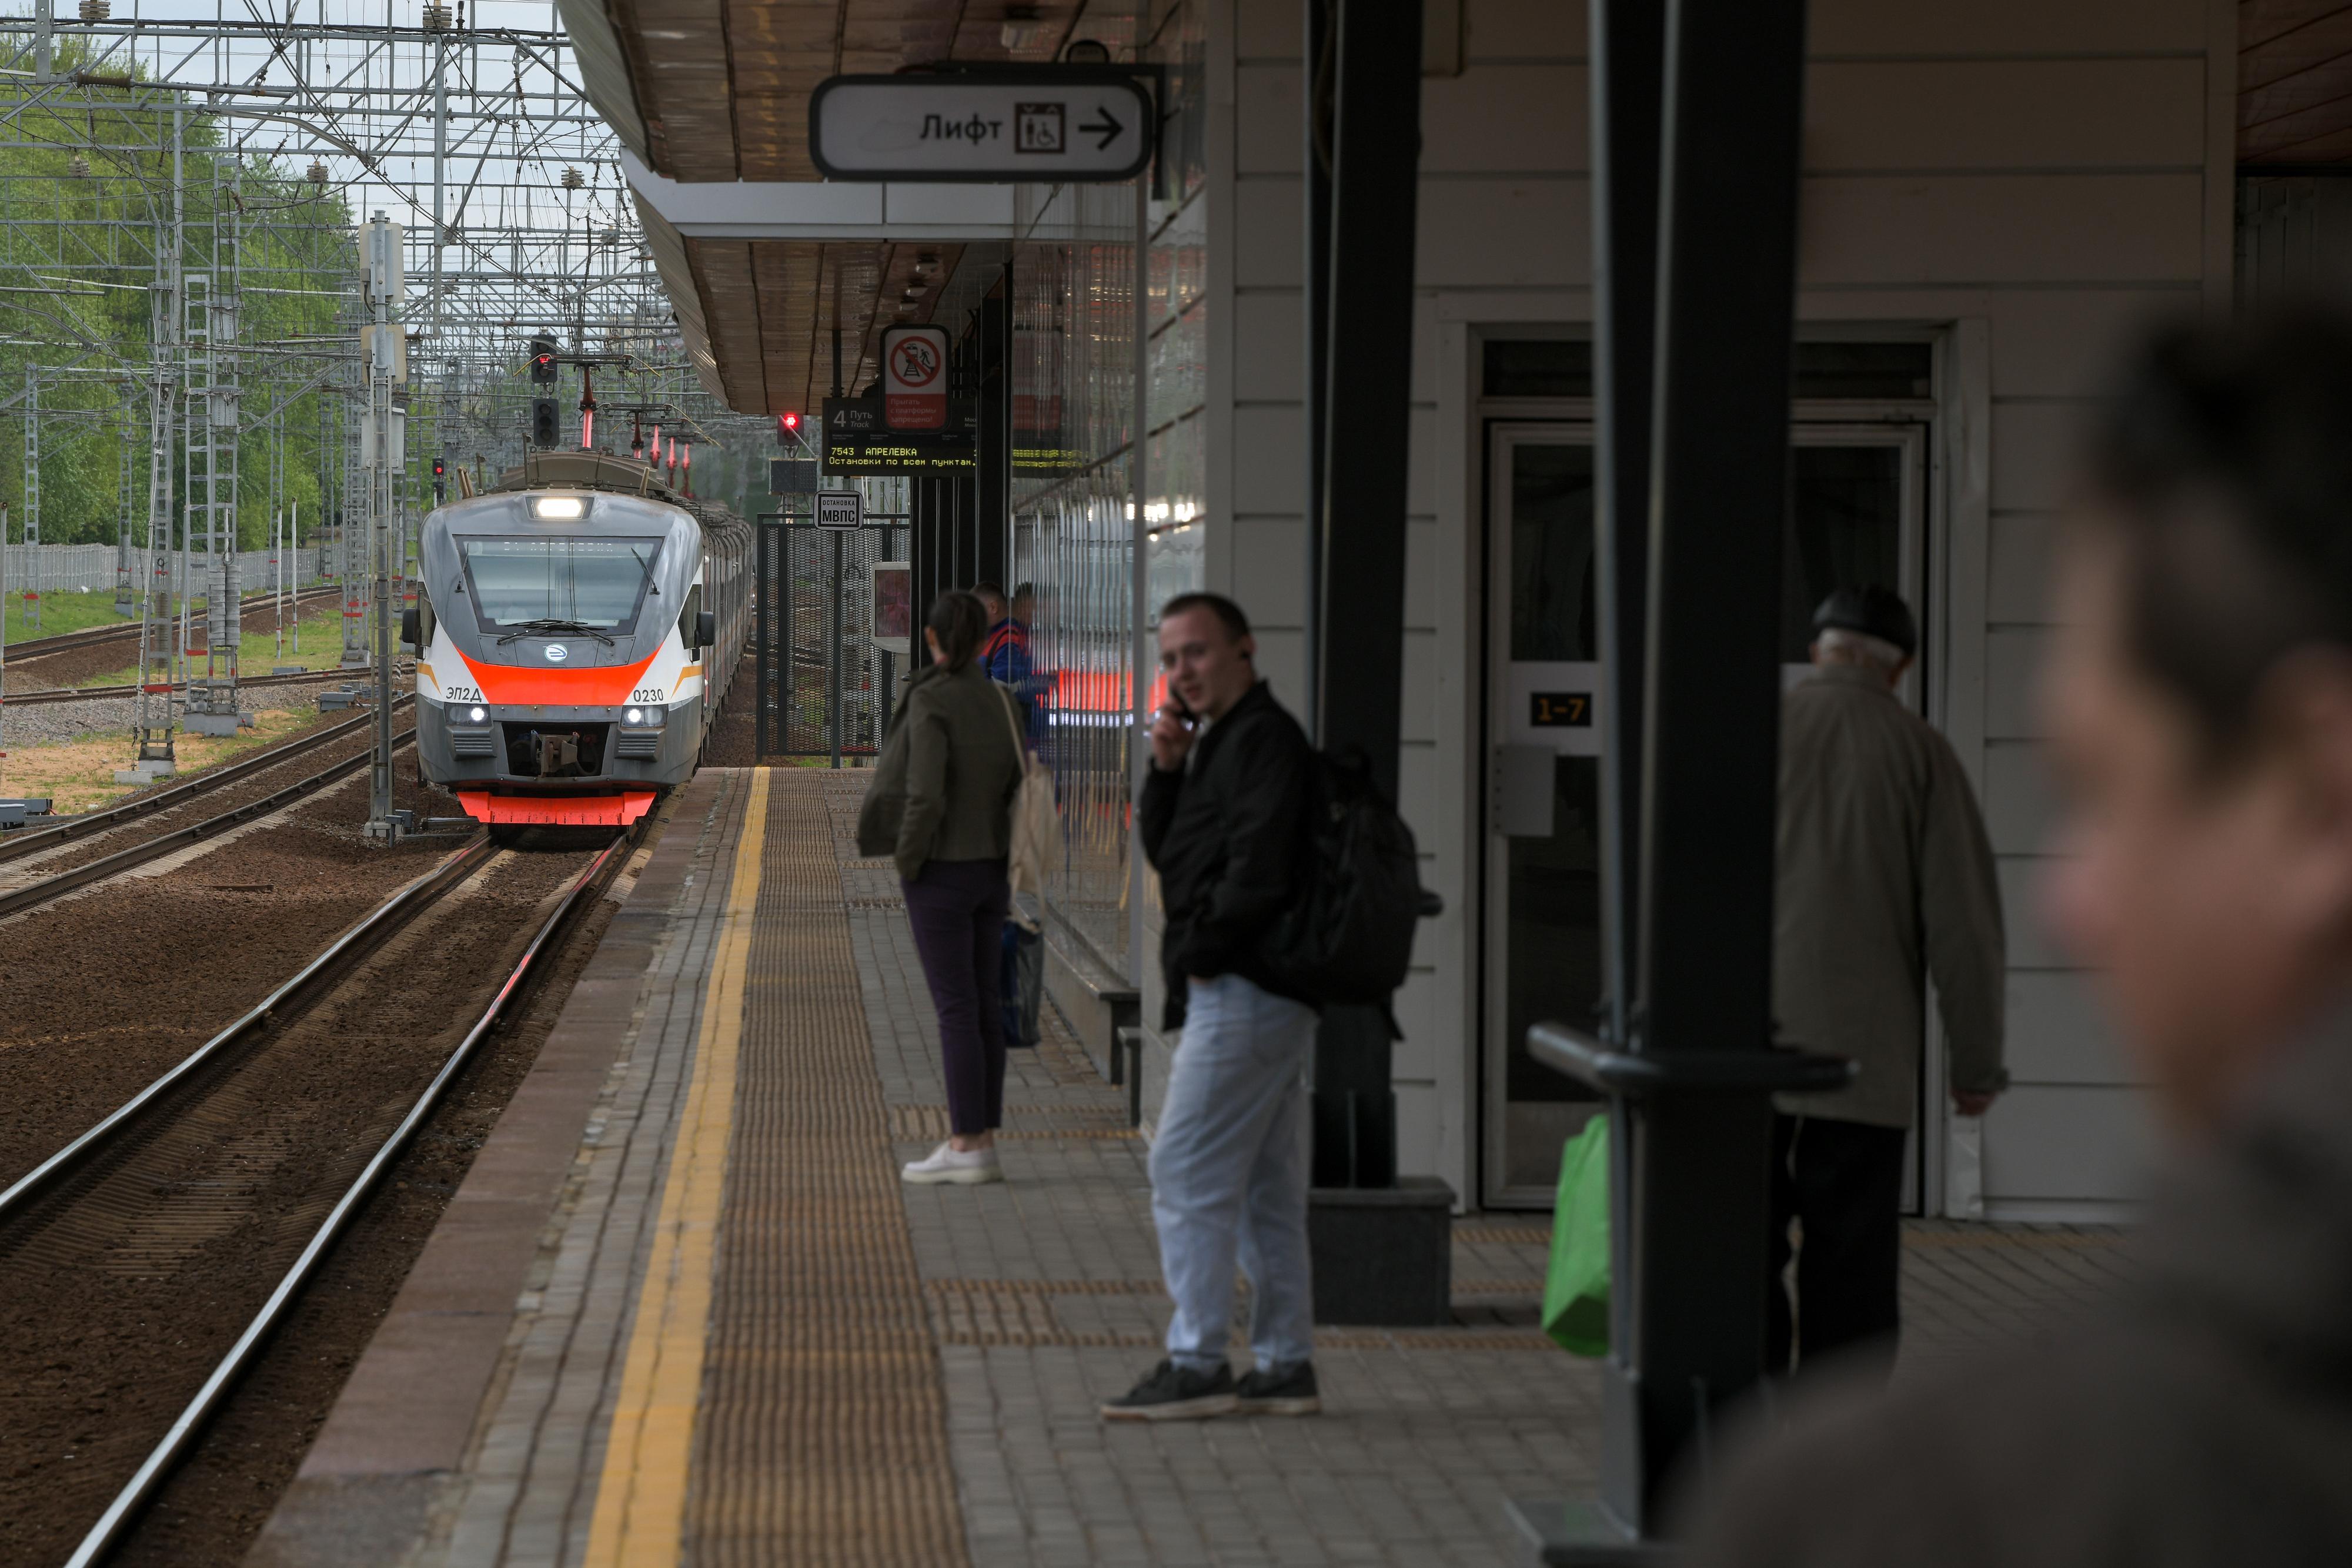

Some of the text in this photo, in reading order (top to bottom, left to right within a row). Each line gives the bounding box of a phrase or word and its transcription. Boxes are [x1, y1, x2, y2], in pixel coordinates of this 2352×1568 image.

[920, 112, 1003, 145] Лифт
[890, 398, 920, 406] Прыгать
[833, 410, 873, 427] 4 Путь
[890, 416, 933, 424] запрещено!
[831, 447, 917, 456] 7543 АПРЕЛЕВКА
[828, 457, 881, 465] Остановки
[822, 510, 855, 523] МВПС
[446, 687, 482, 703] ЭП2Д
[633, 688, 663, 702] 0230
[1538, 698, 1585, 722] 1-7
